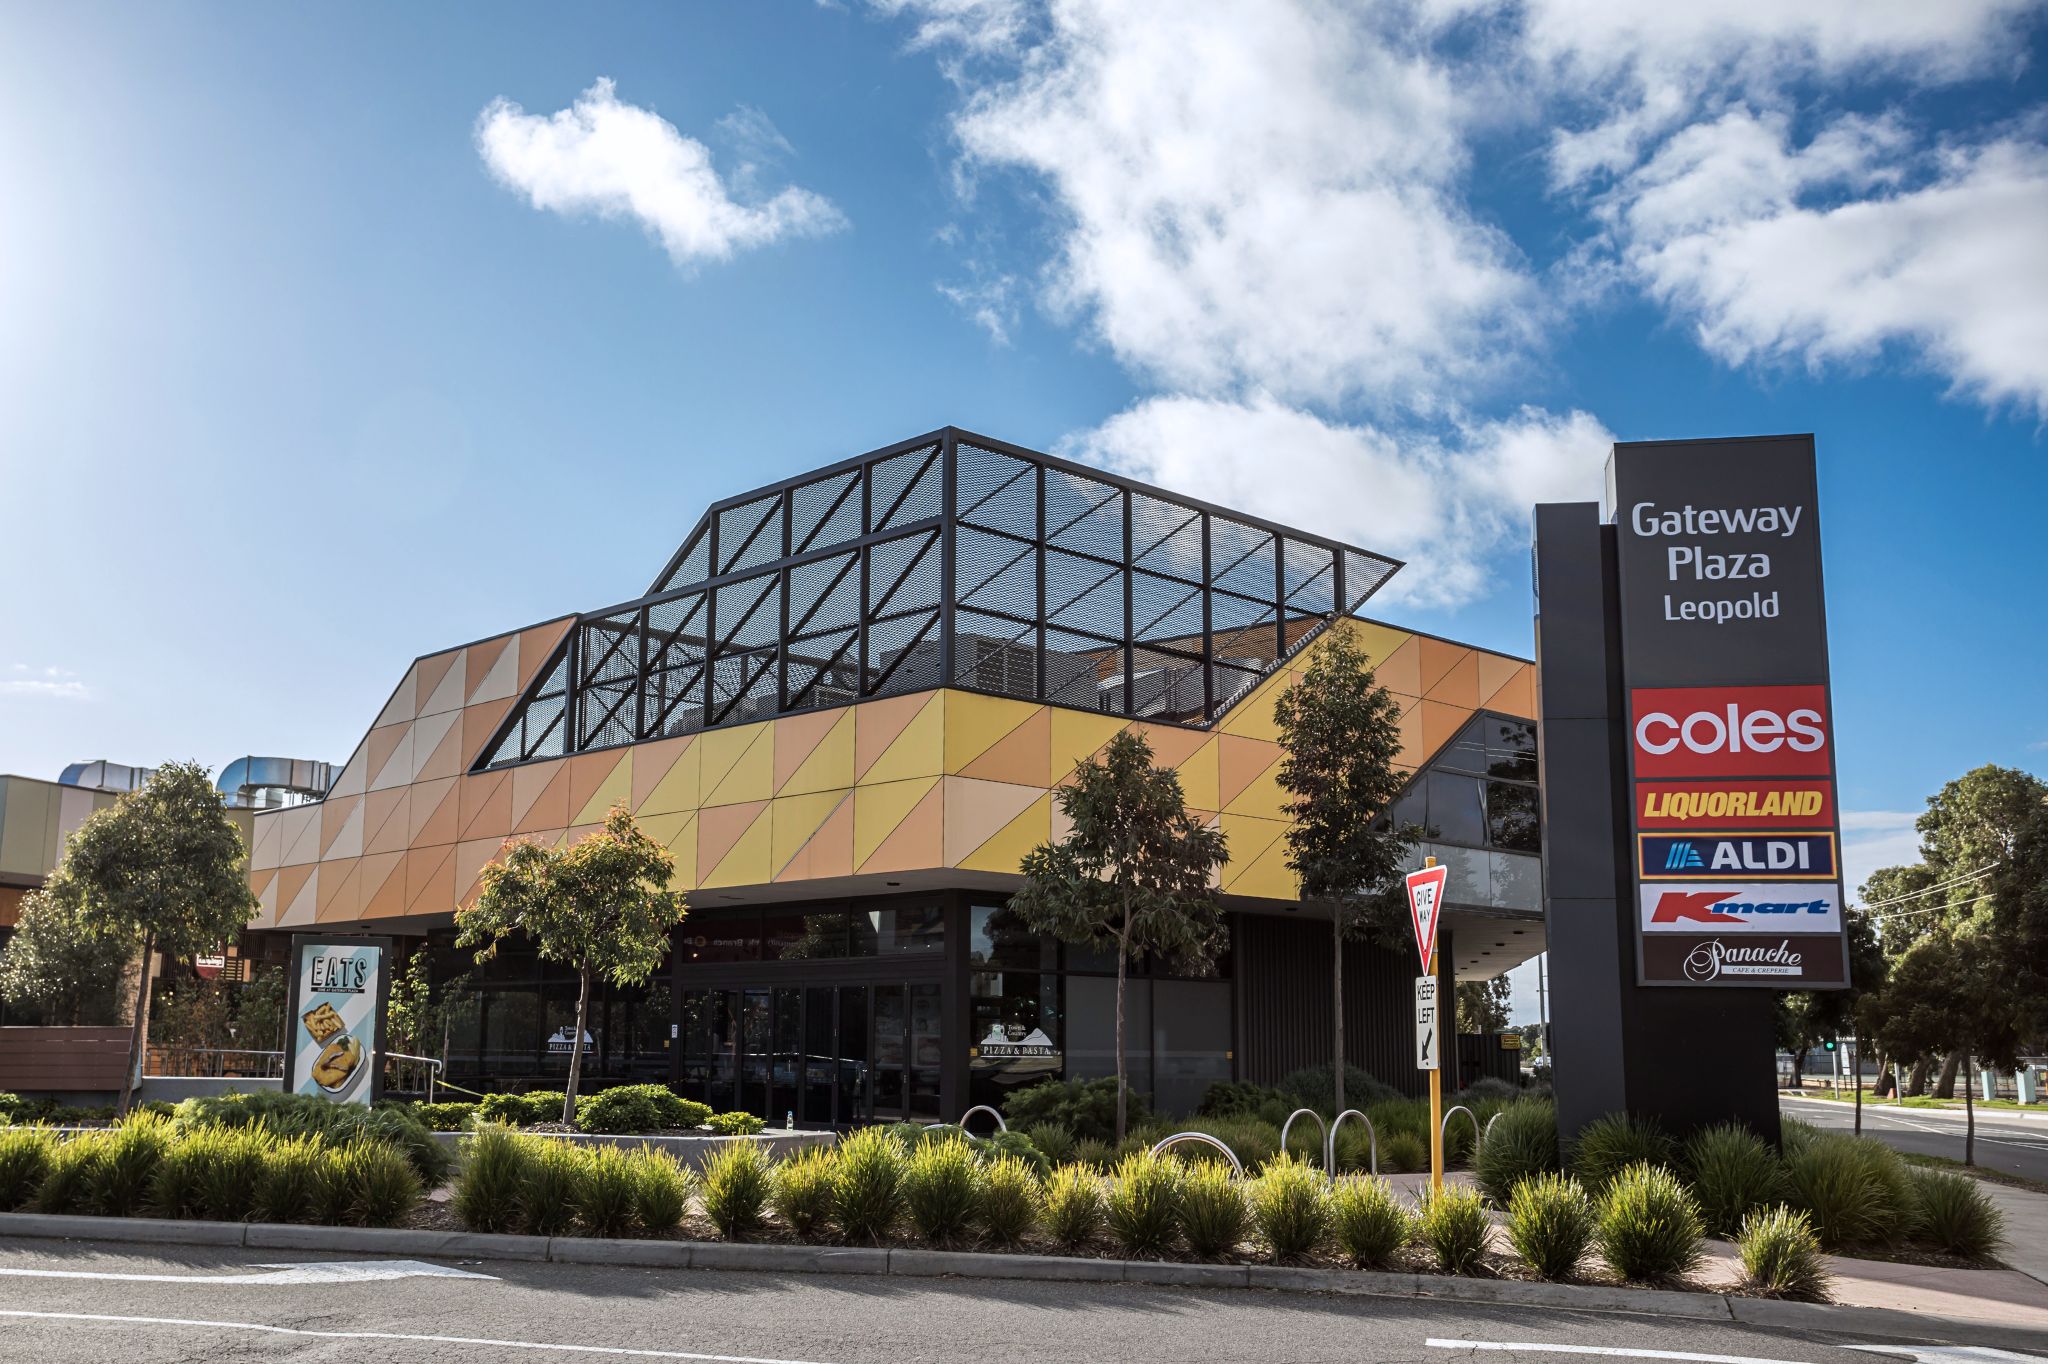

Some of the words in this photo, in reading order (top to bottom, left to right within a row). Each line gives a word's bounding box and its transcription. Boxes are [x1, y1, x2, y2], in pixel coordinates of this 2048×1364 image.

[1631, 502, 1802, 537] Gateway
[1667, 546, 1771, 581] Plaza
[1664, 591, 1780, 624] Leopold
[1635, 703, 1825, 755] coles
[1643, 791, 1823, 820] LIQUORLAND
[1710, 841, 1810, 870] ALDI
[1416, 888, 1433, 907] GIVE
[1650, 891, 1831, 923] Kmart
[1419, 909, 1431, 922] WAY
[311, 956, 367, 988] EATS
[1683, 937, 1802, 982] Panache
[1416, 983, 1435, 1000] KEEP
[1417, 1007, 1435, 1024] LEFT
[549, 1043, 567, 1051] PIZZA
[983, 1046, 1012, 1055] PIZZA
[1013, 1047, 1020, 1055] &
[1022, 1046, 1050, 1055] PASTA
